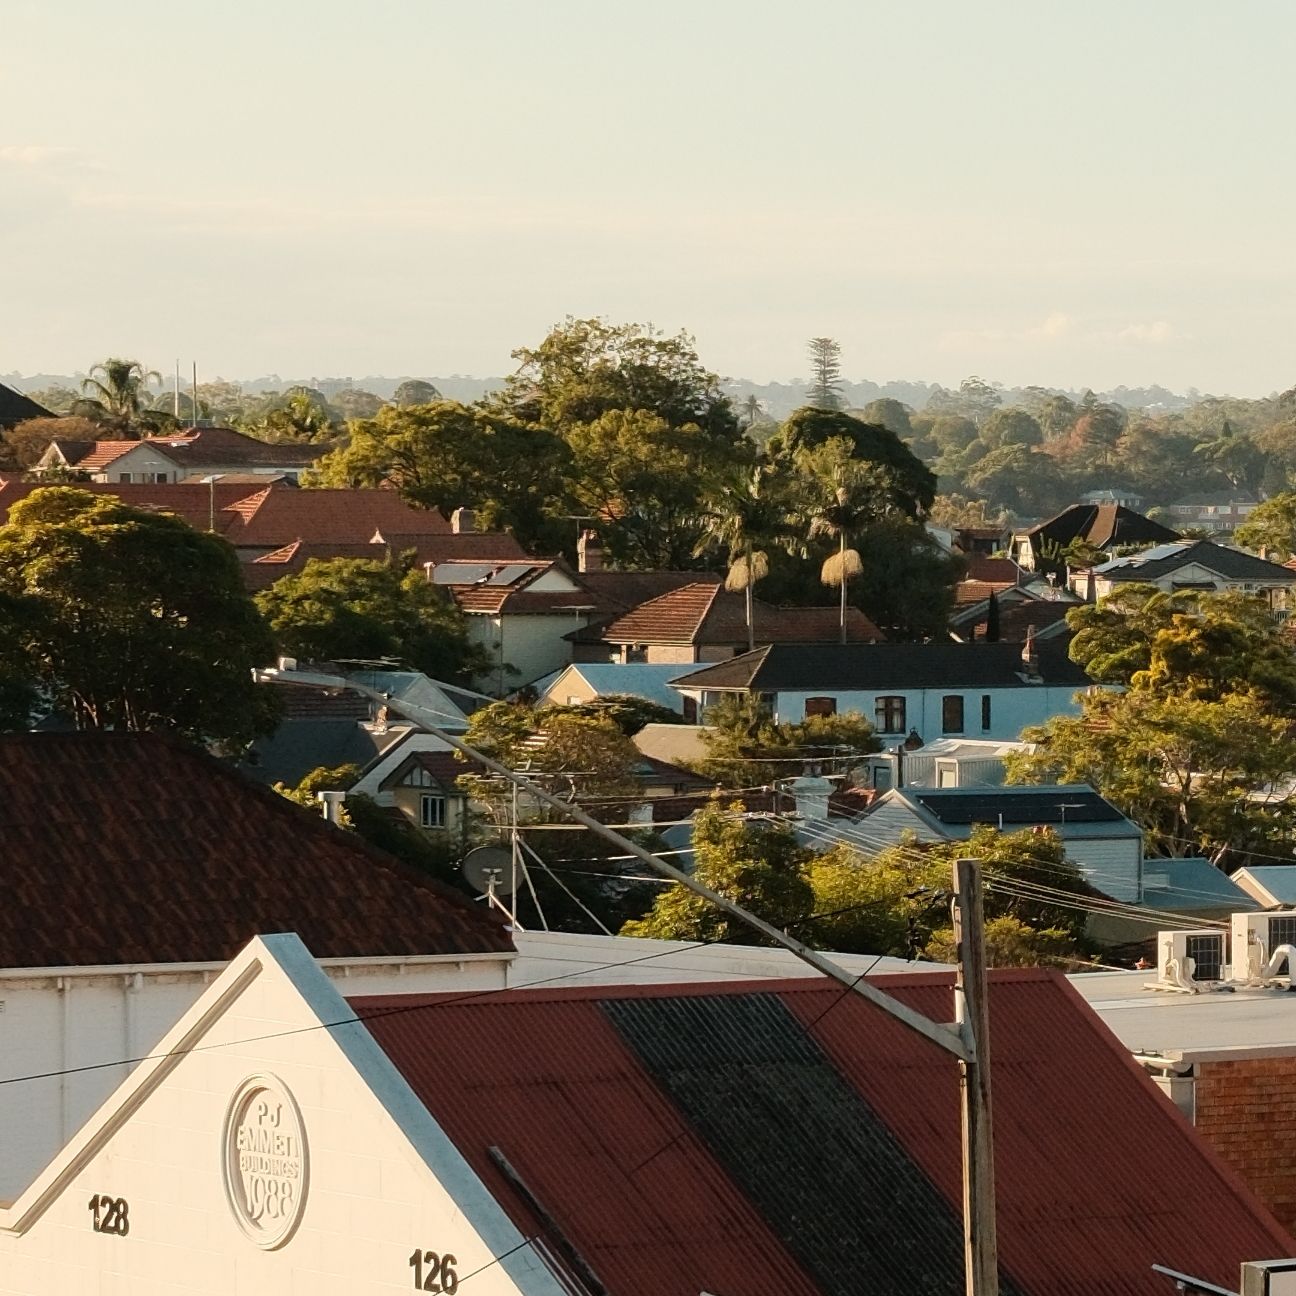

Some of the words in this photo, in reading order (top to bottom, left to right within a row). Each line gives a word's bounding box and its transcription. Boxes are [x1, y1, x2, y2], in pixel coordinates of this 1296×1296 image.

[240, 1155, 299, 1179] BUILDINGS
[89, 1193, 130, 1237] 128
[247, 1175, 294, 1221] 1988
[410, 1247, 458, 1296] 126
